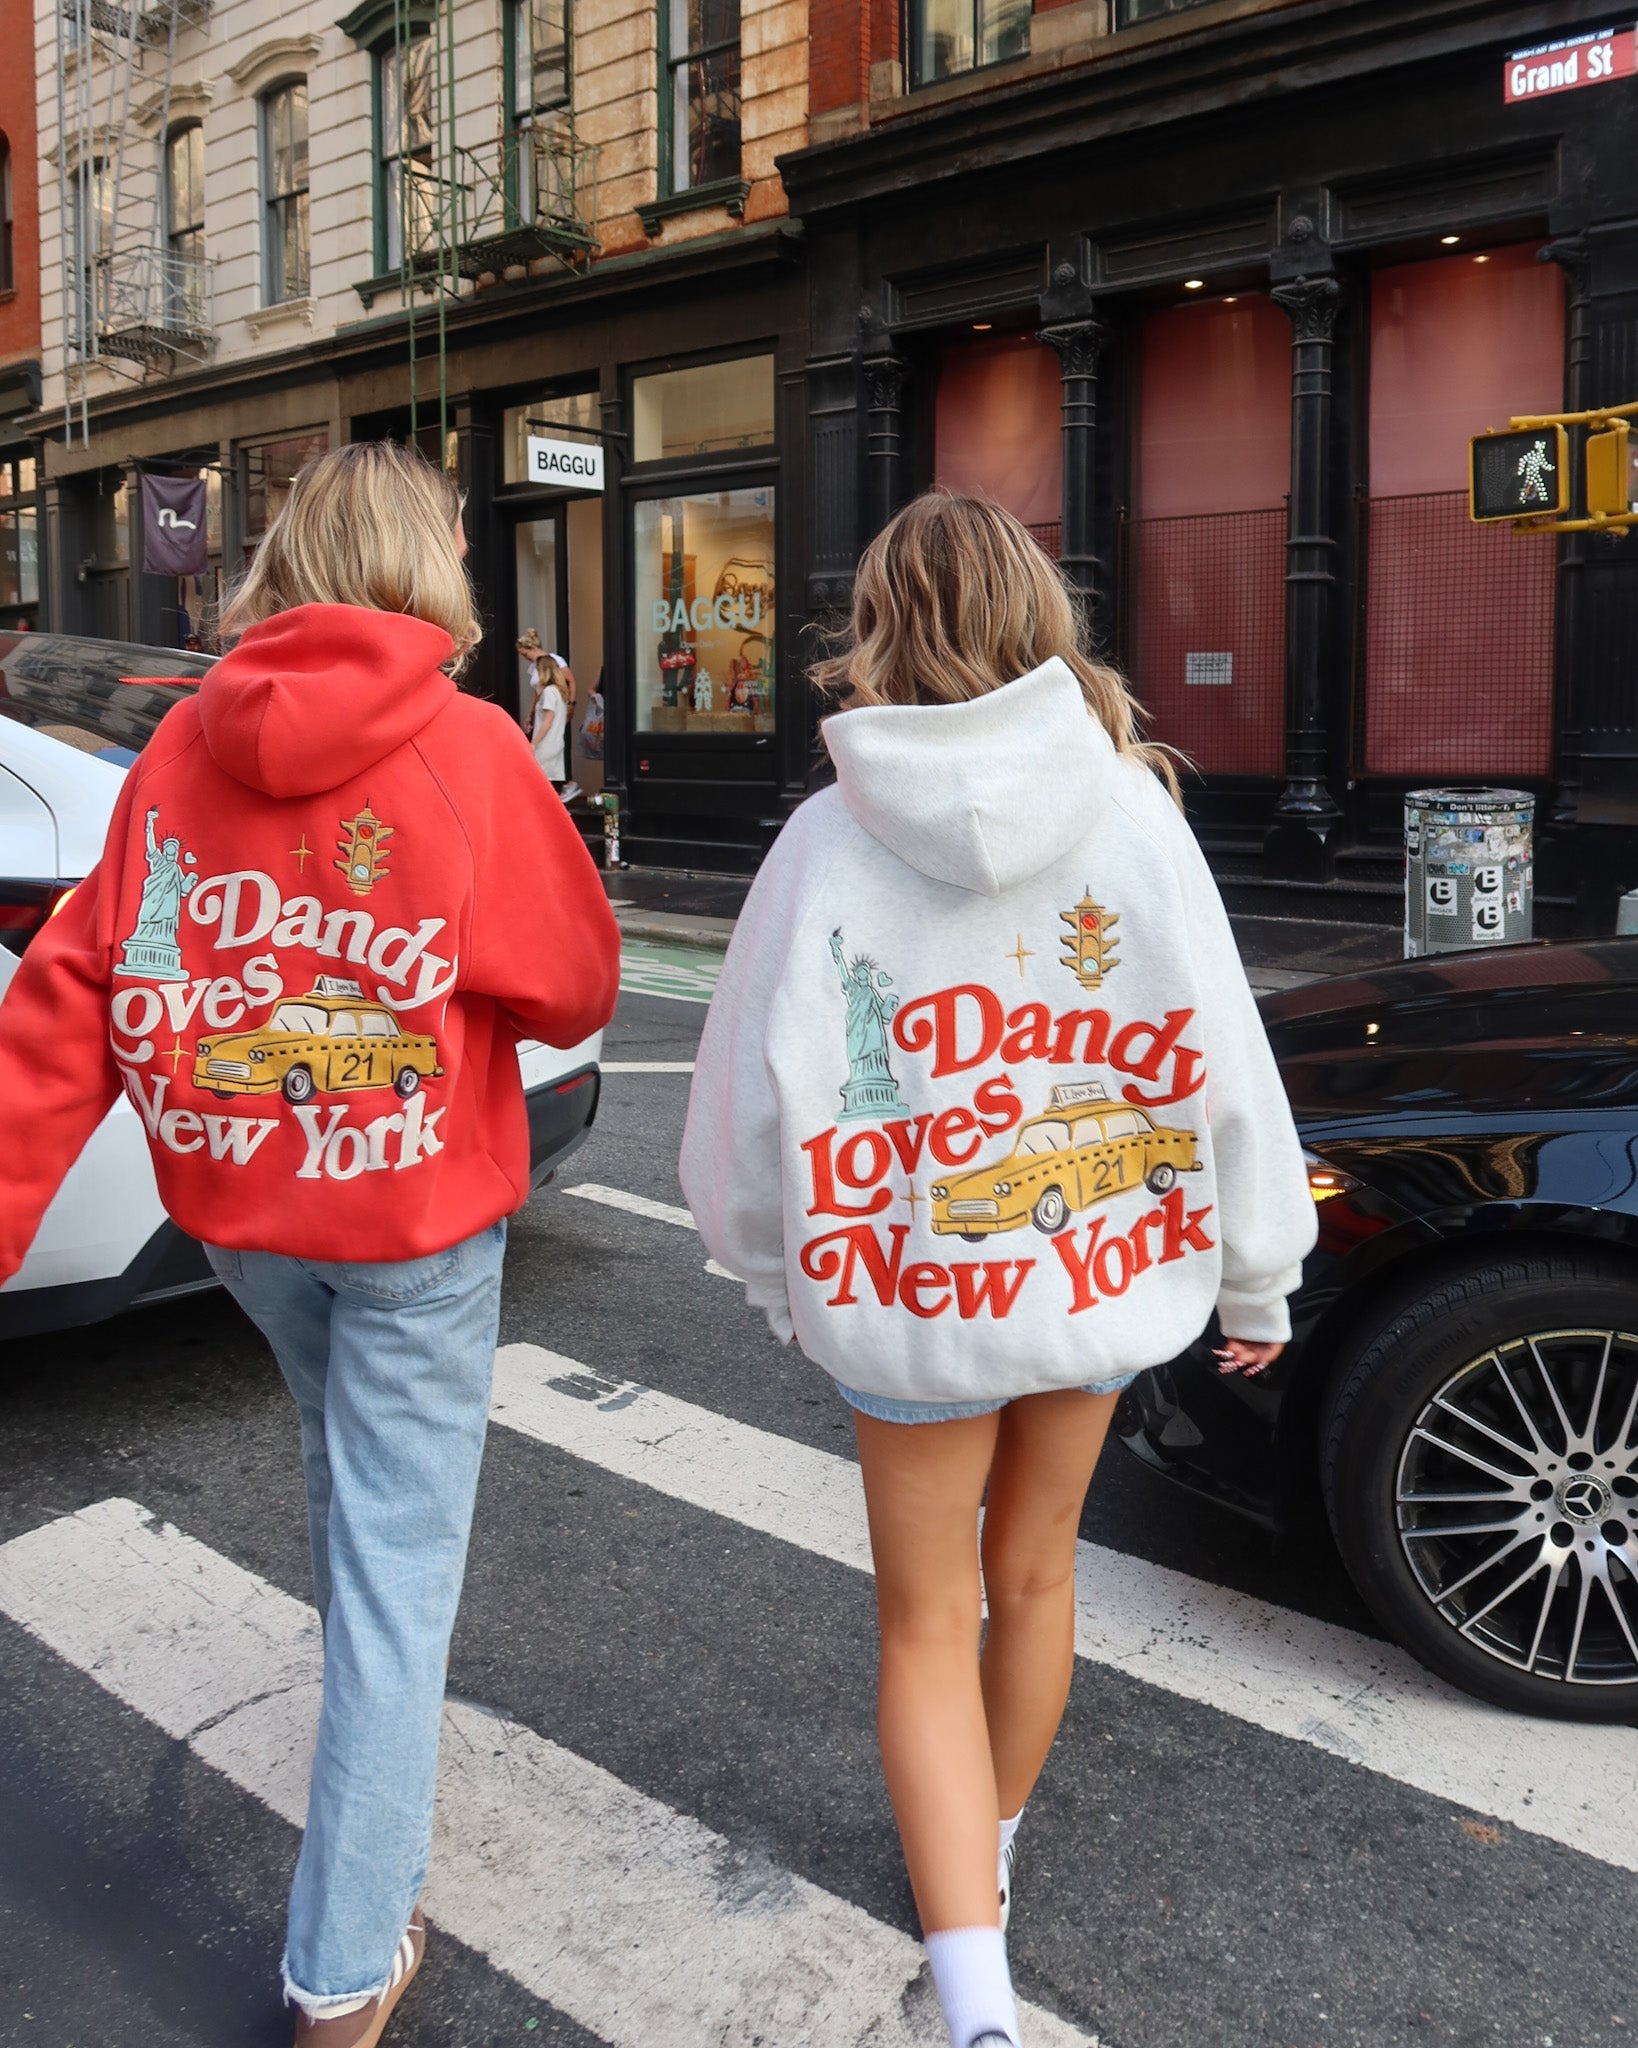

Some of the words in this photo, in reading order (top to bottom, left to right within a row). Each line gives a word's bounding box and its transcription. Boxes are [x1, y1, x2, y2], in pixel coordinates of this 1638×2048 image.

[1511, 50, 1578, 96] Grand
[1587, 43, 1613, 79] St
[537, 451, 596, 476] BAGGU
[651, 592, 760, 633] BAGGU
[1449, 803, 1473, 811] Don't
[1475, 803, 1496, 811] litter
[188, 870, 459, 1011] Dandy
[342, 1053, 374, 1082] 21
[892, 983, 1207, 1107] Dandy
[115, 1060, 280, 1165] New
[292, 1091, 446, 1181] York
[800, 1073, 1024, 1219] Loves
[1091, 1158, 1125, 1194] 21
[800, 1223, 1037, 1319] New
[1051, 1187, 1216, 1316] York
